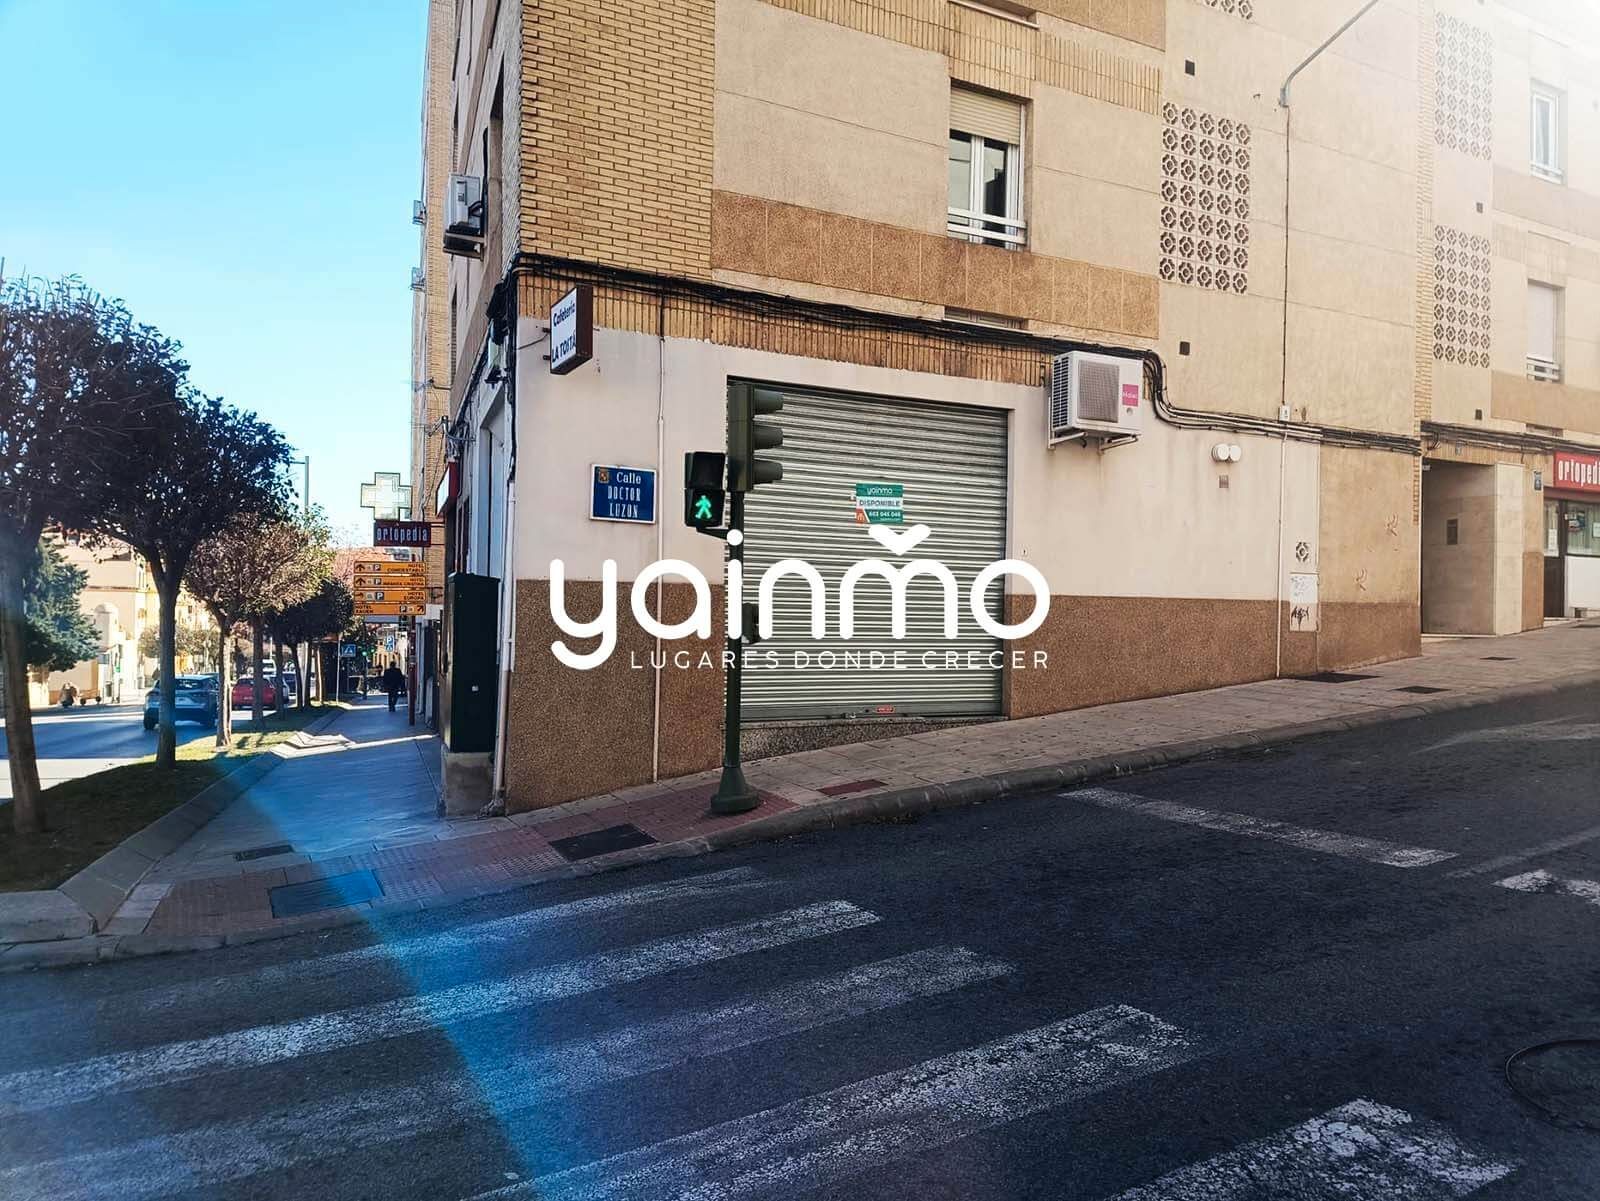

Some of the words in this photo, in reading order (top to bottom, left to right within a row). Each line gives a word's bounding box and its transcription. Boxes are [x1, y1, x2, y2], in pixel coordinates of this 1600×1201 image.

[552, 345, 559, 363] LA
[616, 471, 641, 484] Calle
[607, 485, 641, 502] DOCTOR
[377, 527, 427, 543] ortopedia
